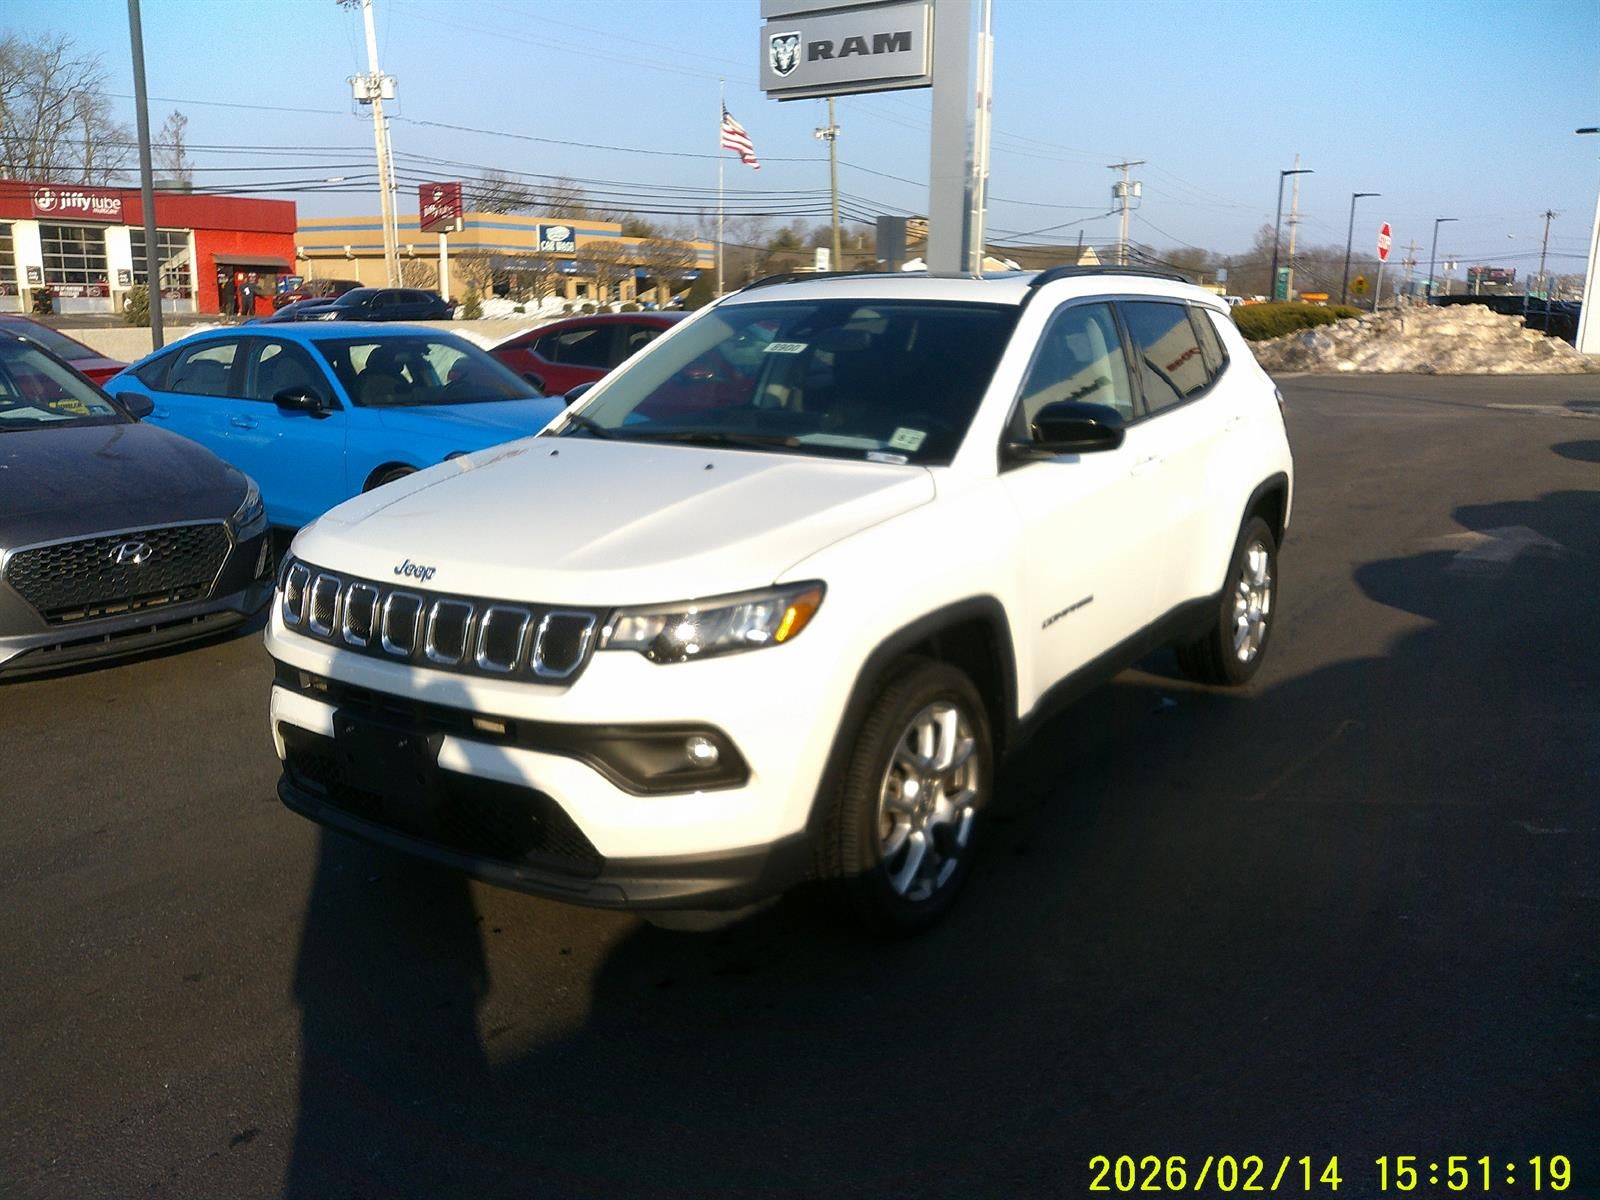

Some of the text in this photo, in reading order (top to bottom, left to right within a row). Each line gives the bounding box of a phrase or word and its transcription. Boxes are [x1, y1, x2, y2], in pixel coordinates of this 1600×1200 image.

[807, 31, 912, 62] RAM
[60, 191, 91, 211] jiffy
[393, 558, 436, 582] Jeep
